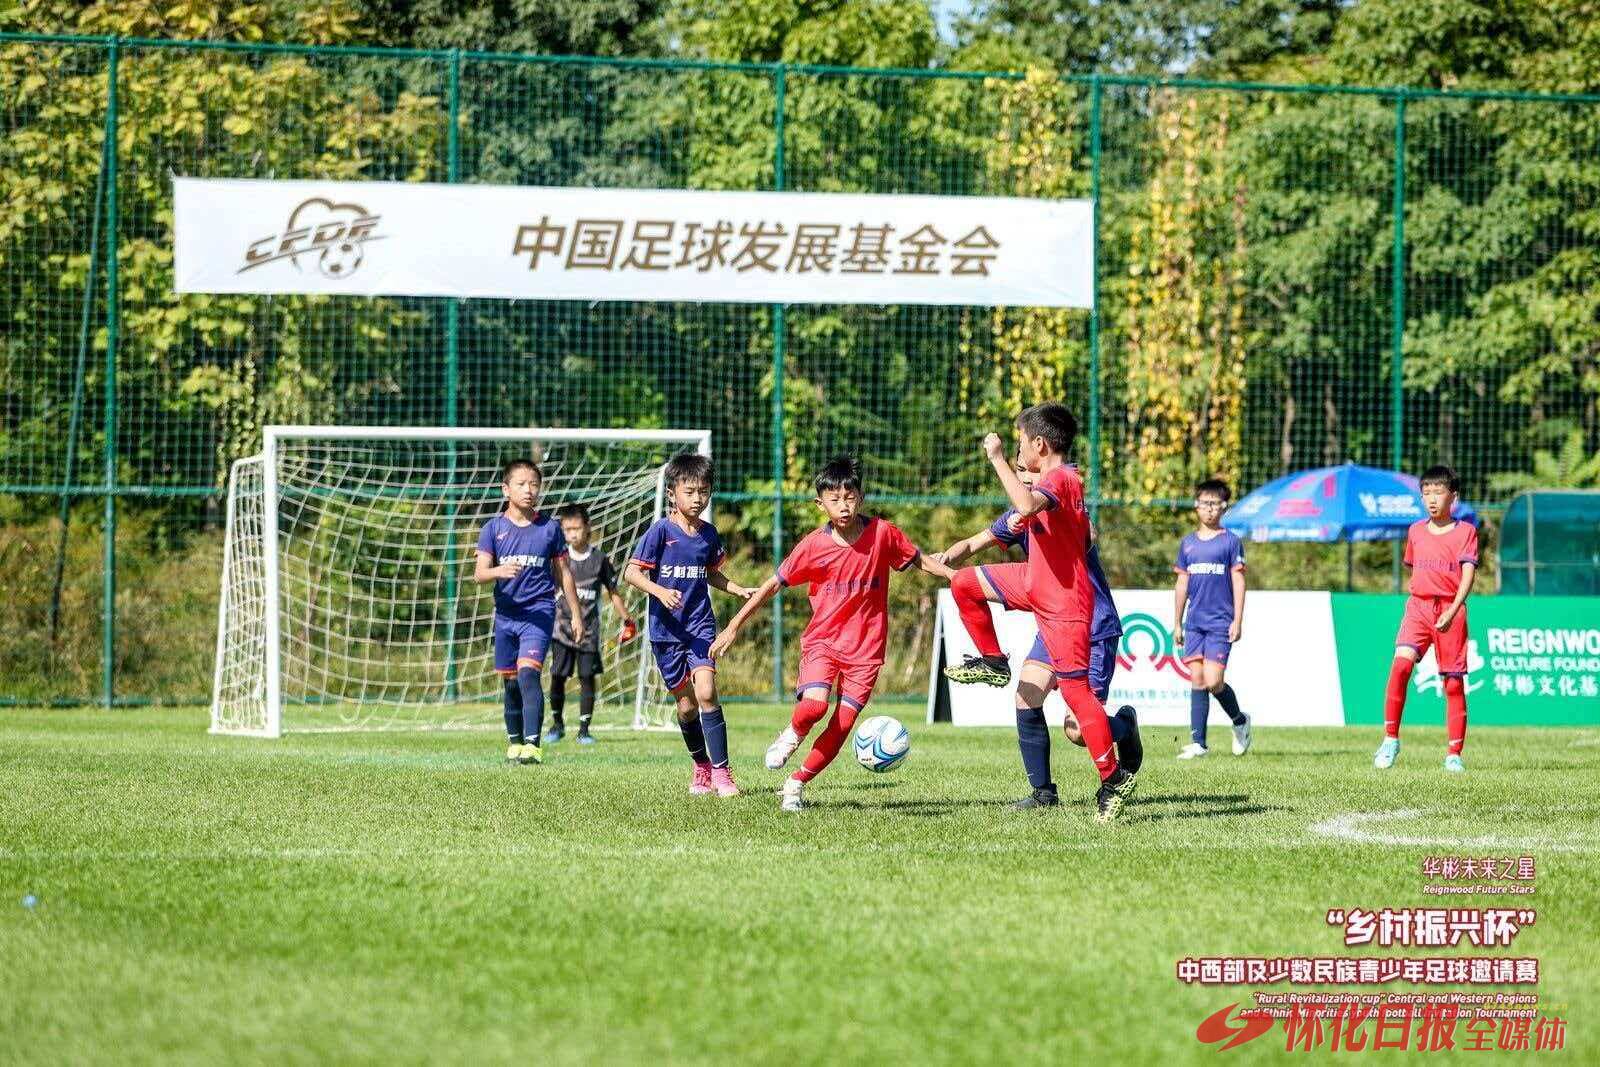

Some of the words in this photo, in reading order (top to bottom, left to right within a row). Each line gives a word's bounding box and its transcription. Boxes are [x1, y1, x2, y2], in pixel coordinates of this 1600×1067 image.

[512, 215, 1001, 277] 中国足球发展基金会
[1490, 656, 1552, 671] CULTURE
